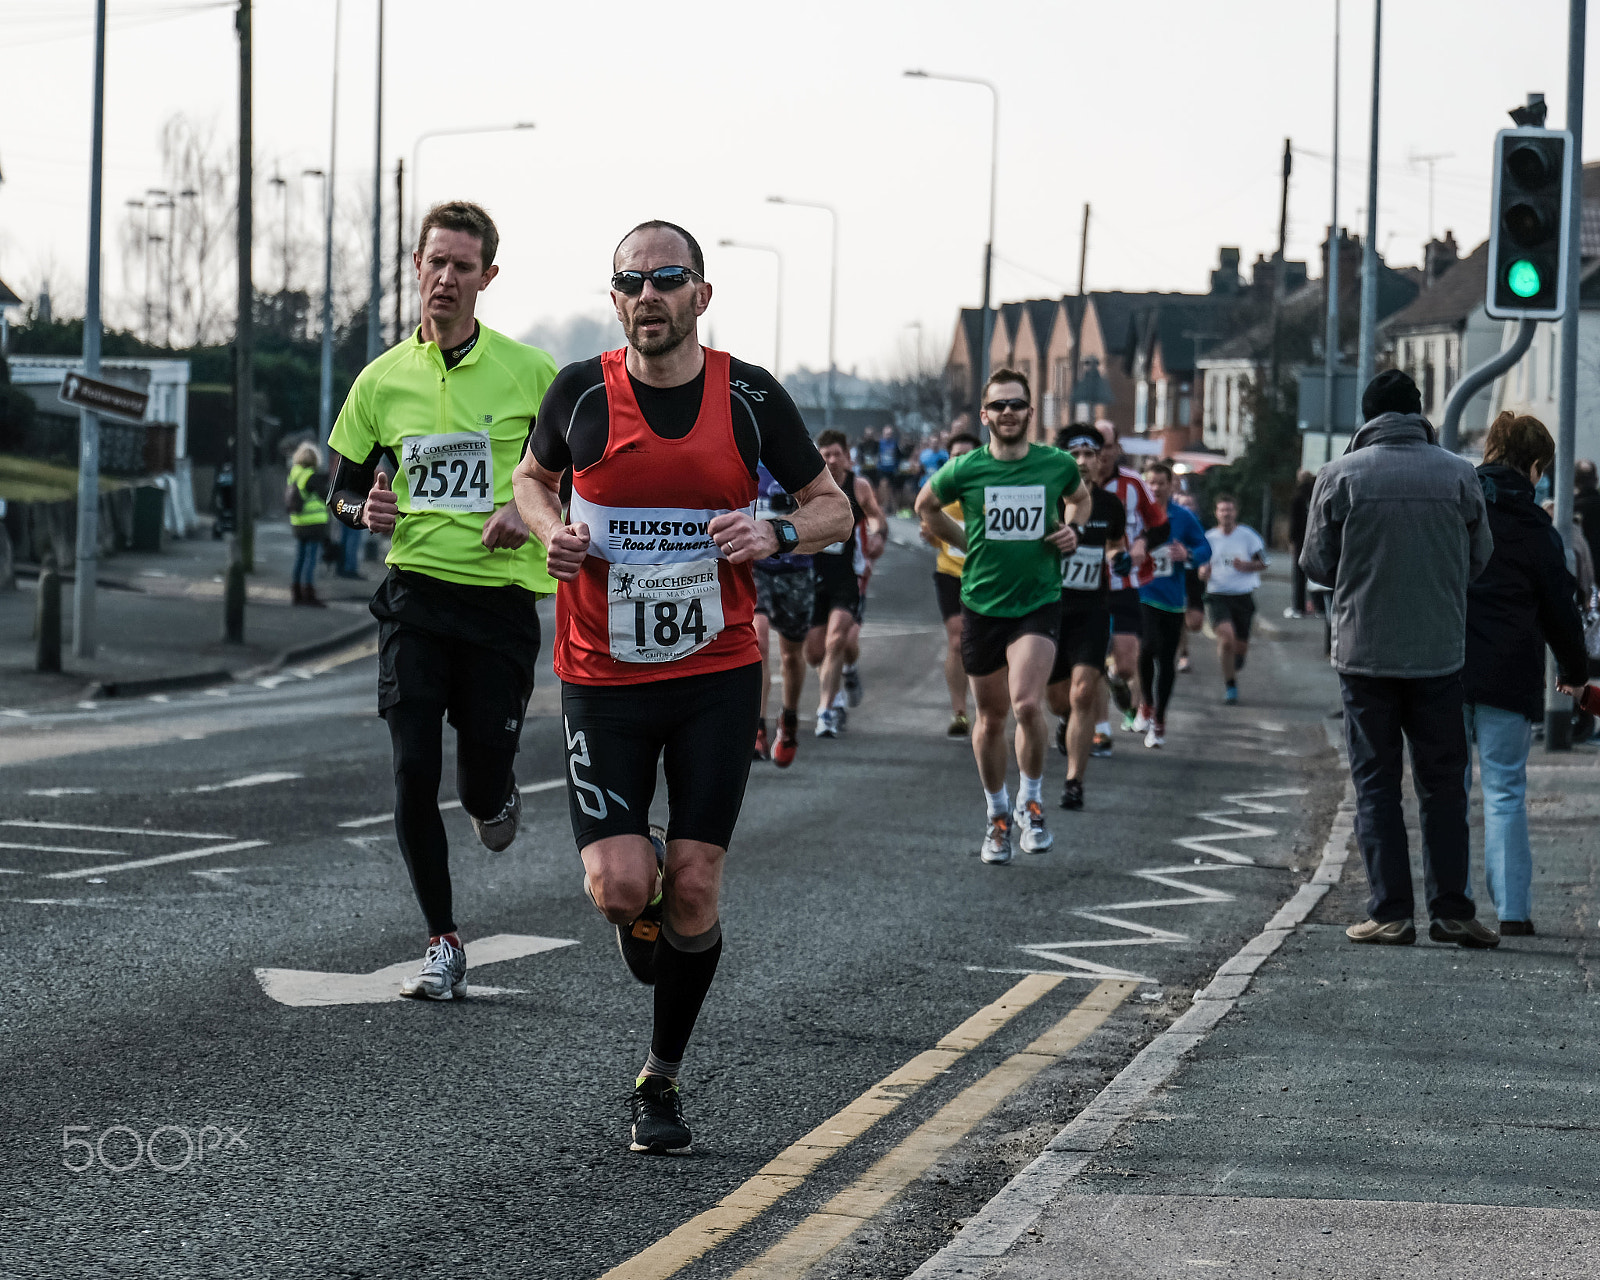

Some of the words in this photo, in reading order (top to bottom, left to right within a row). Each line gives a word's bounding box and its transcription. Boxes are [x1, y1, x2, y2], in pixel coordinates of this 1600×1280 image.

[423, 442, 486, 454] COLCHESTER
[409, 459, 489, 498] 2524
[988, 507, 1042, 532] 2007
[622, 538, 656, 550] Road
[658, 539, 710, 551] Runners
[637, 572, 714, 589] COLCHESTER
[666, 585, 715, 598] MARATHON
[635, 598, 707, 647] 184
